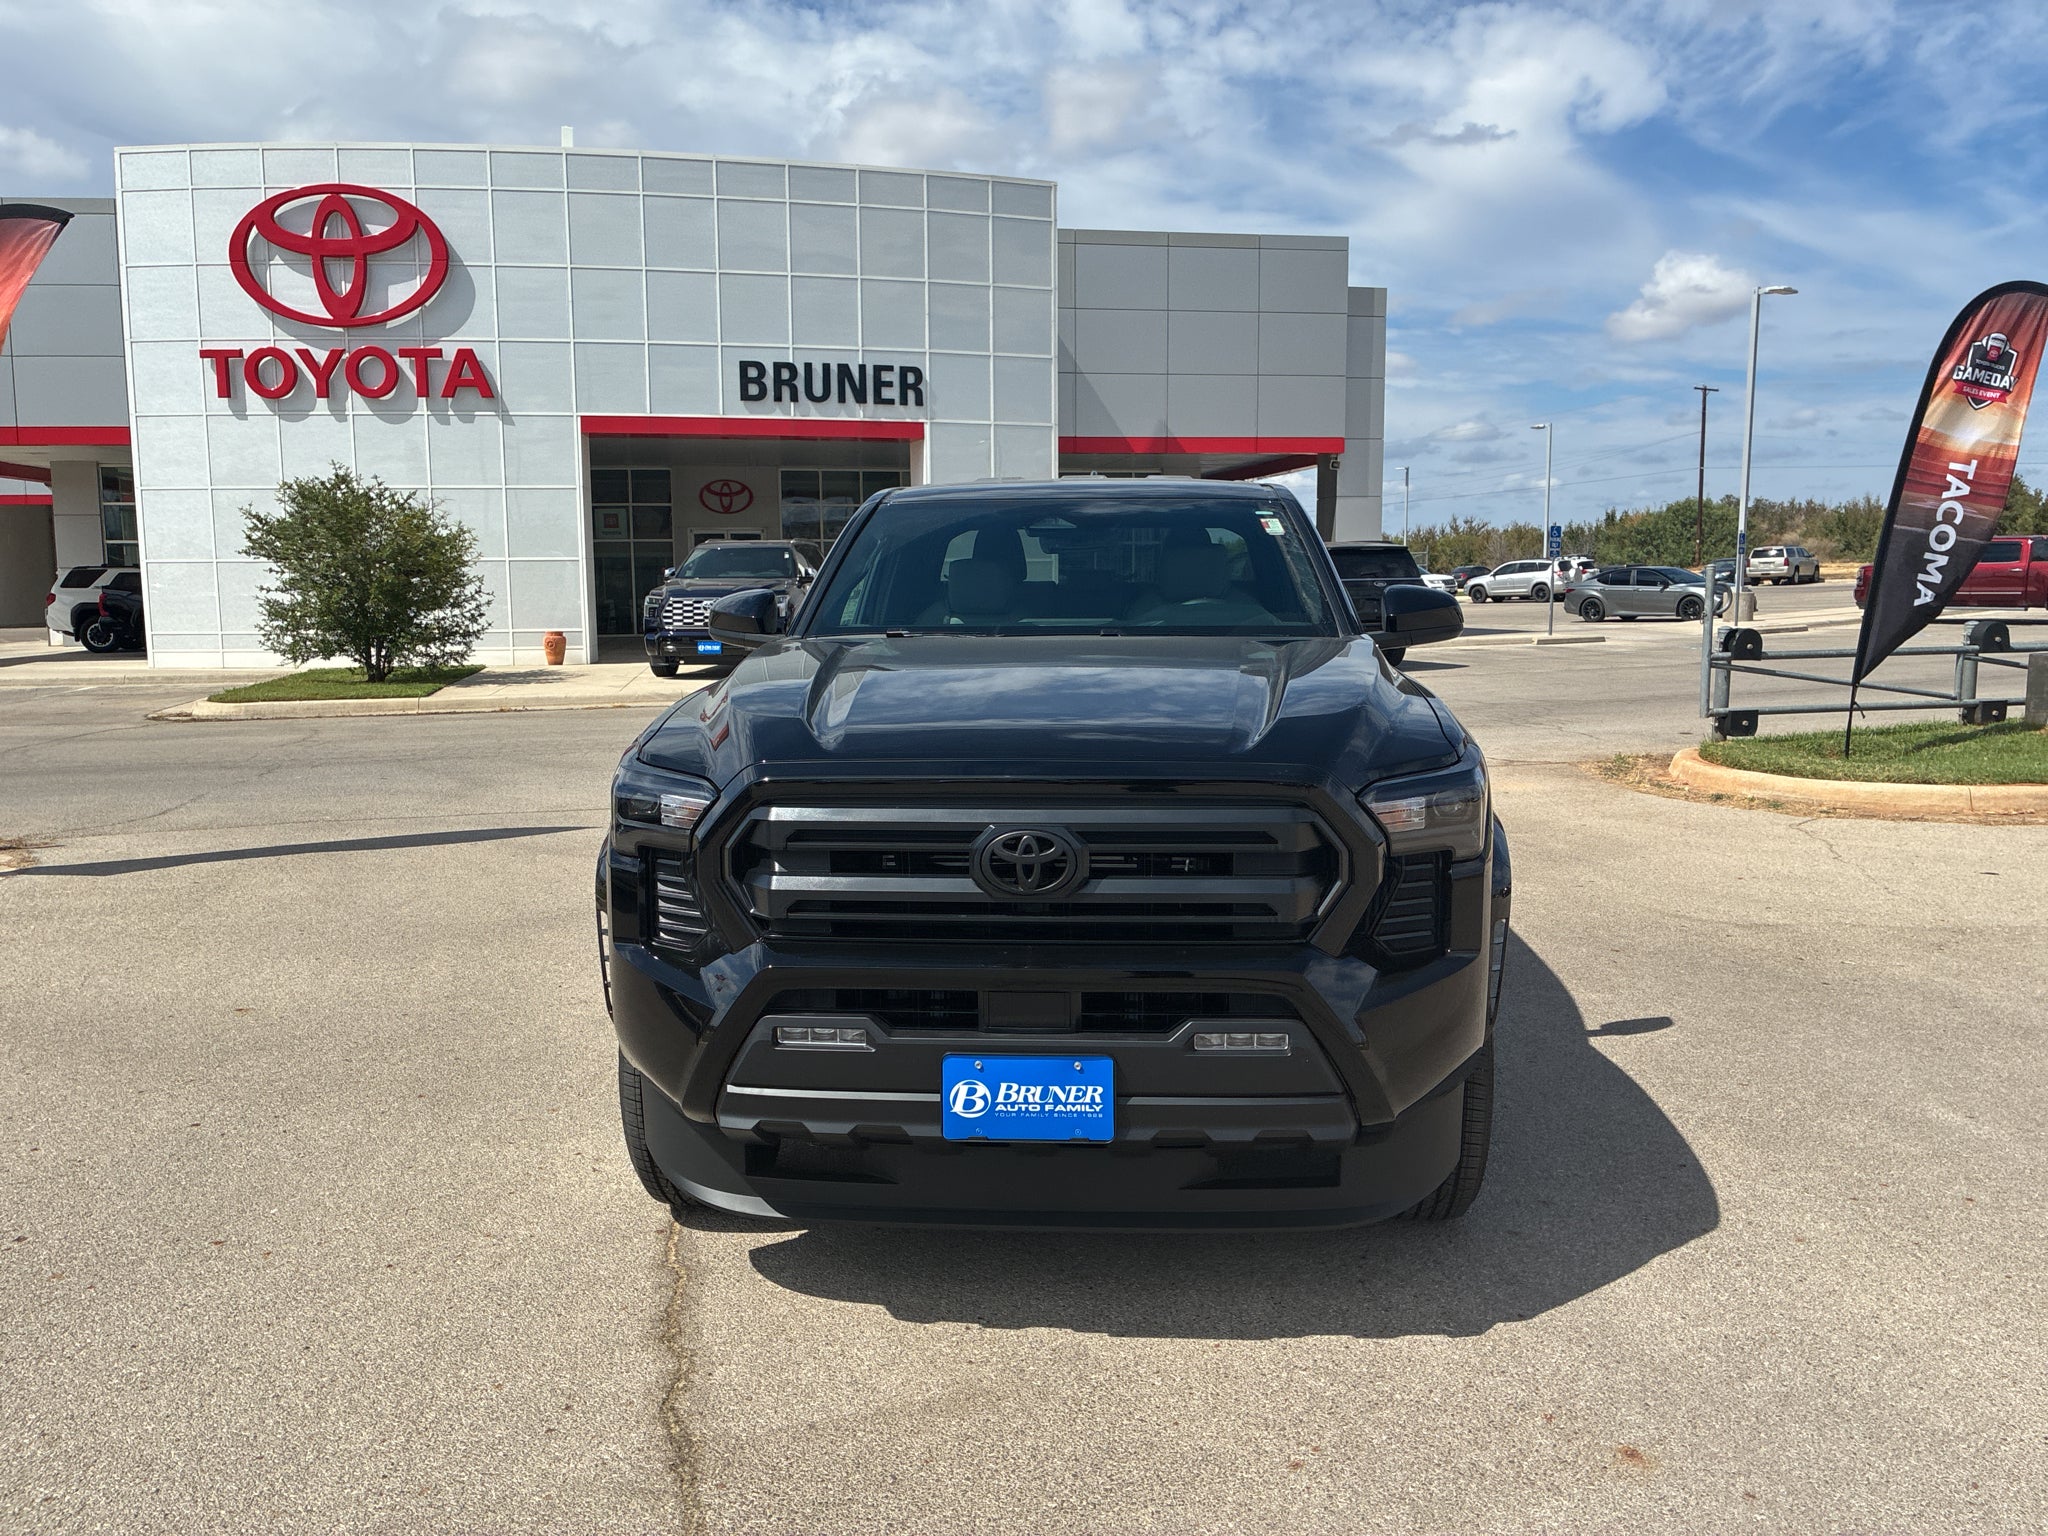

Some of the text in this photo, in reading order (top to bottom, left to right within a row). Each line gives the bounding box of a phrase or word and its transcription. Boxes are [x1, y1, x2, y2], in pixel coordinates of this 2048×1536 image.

[200, 346, 495, 399] TOYOTA
[739, 360, 924, 407] BRUNER
[1952, 365, 2019, 392] GAMEDAY
[1962, 386, 2001, 399] SALES EVENT
[1913, 459, 1979, 607] TACOMA
[950, 1082, 988, 1114] B
[995, 1082, 1104, 1104] BRUNER
[995, 1104, 1104, 1112] AUTO FAMILY
